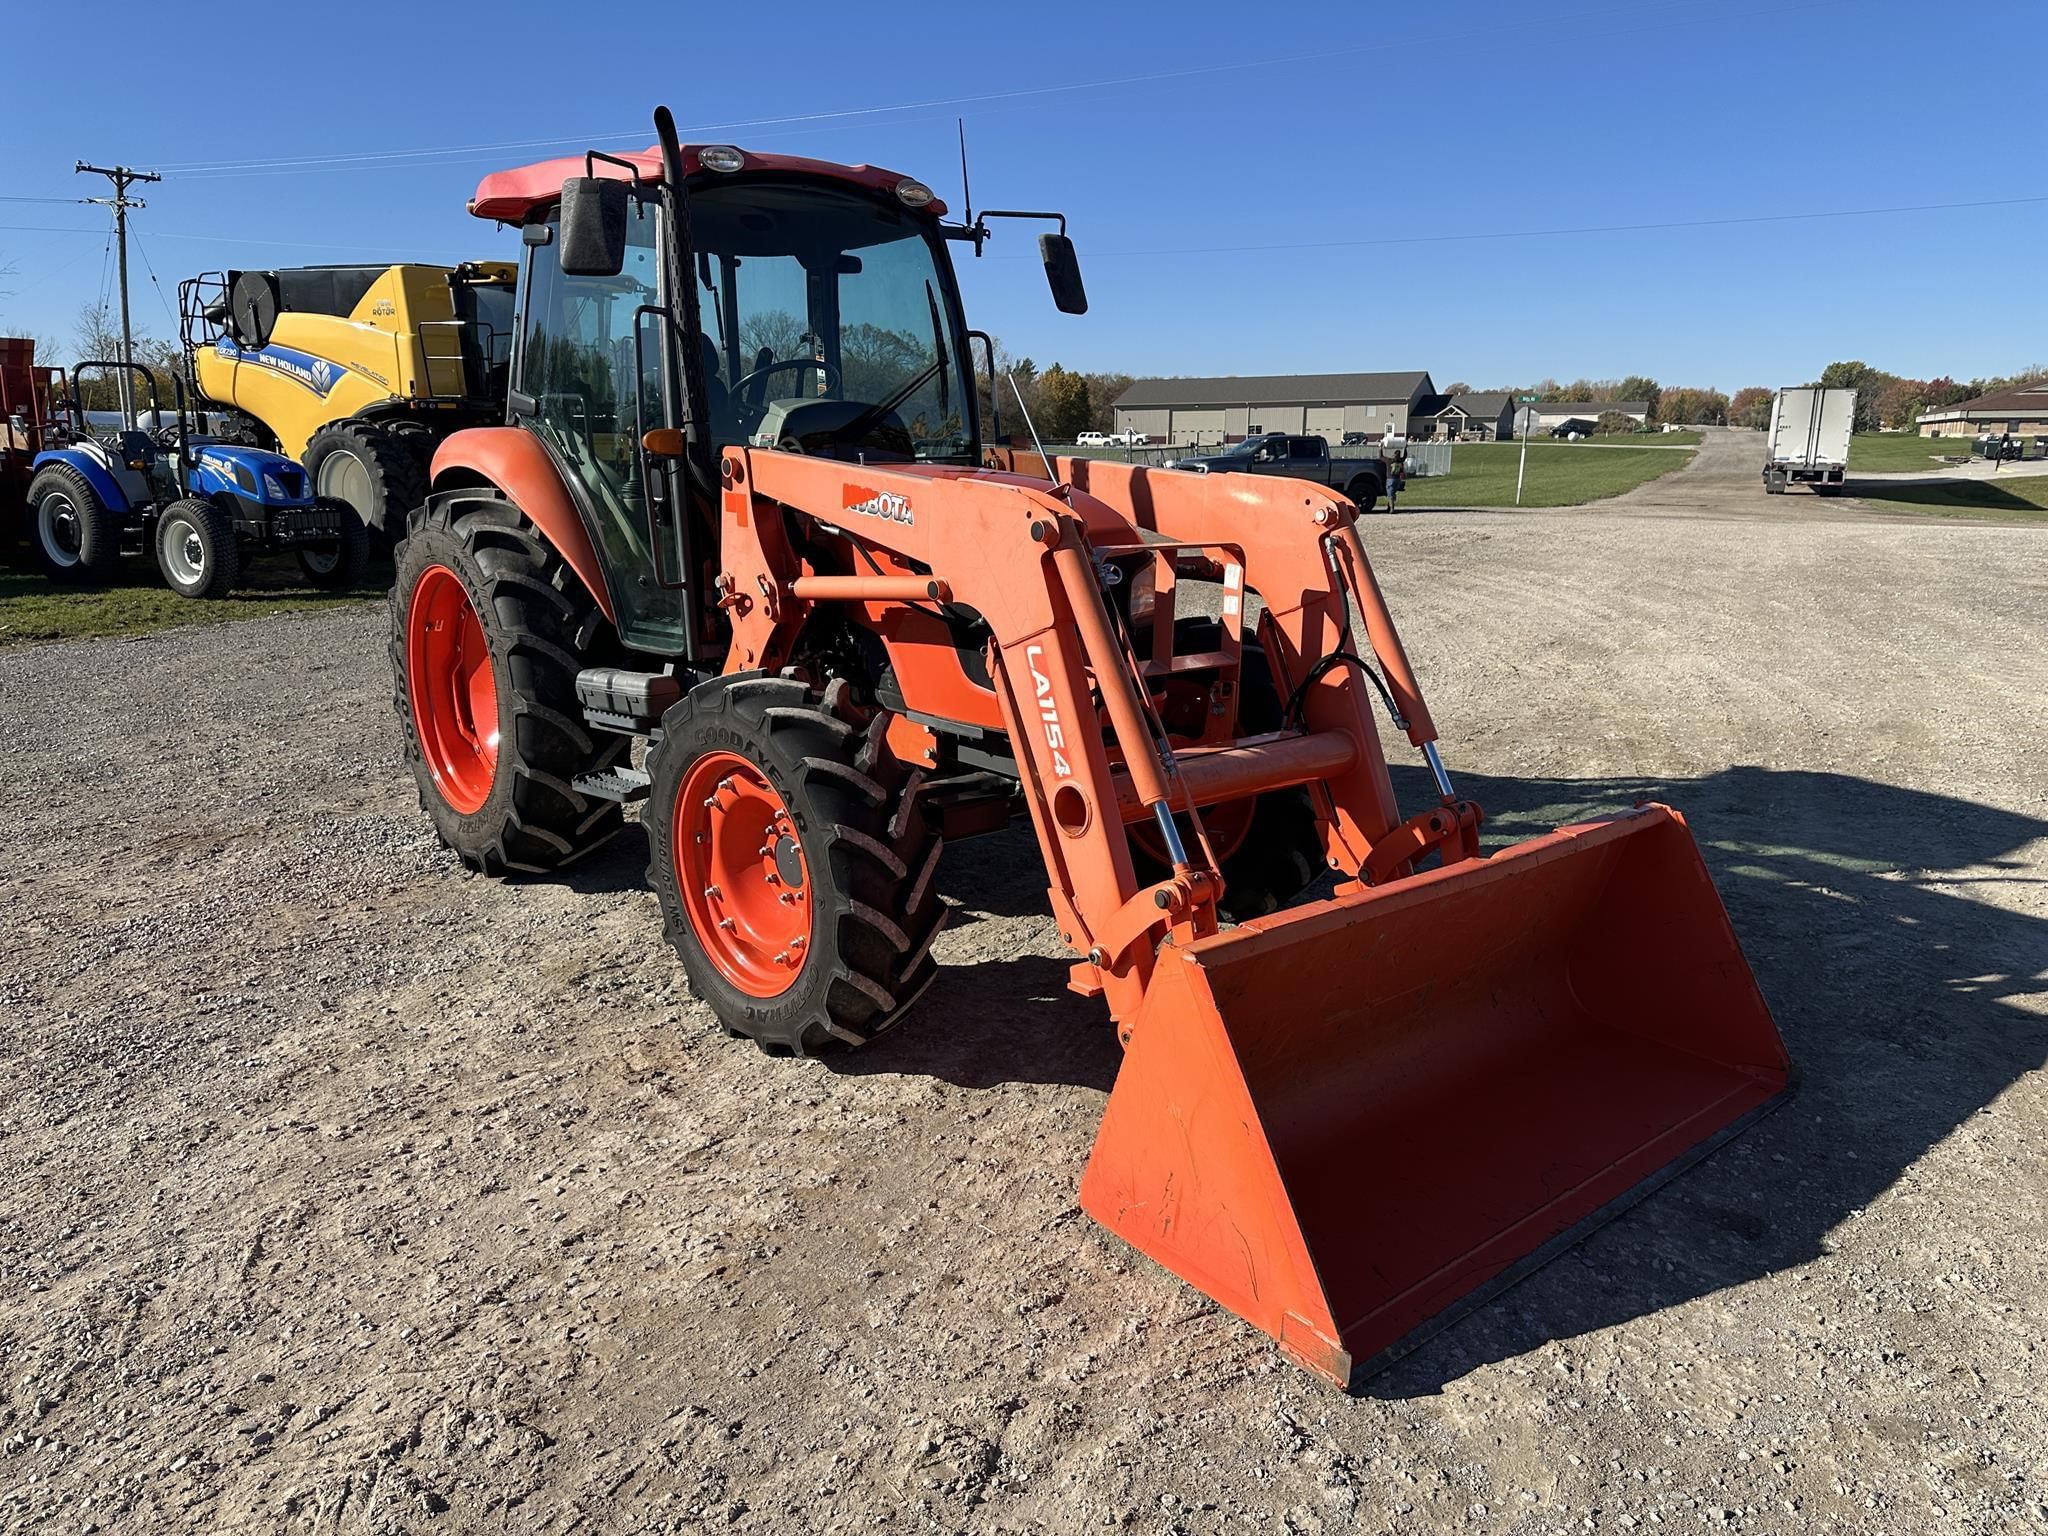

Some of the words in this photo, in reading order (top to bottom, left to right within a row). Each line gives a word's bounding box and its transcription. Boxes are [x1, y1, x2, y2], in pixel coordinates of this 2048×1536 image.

[259, 354, 277, 366] NEW
[277, 359, 312, 381] HOLLAND
[744, 963, 820, 1024] OPTITRAC
